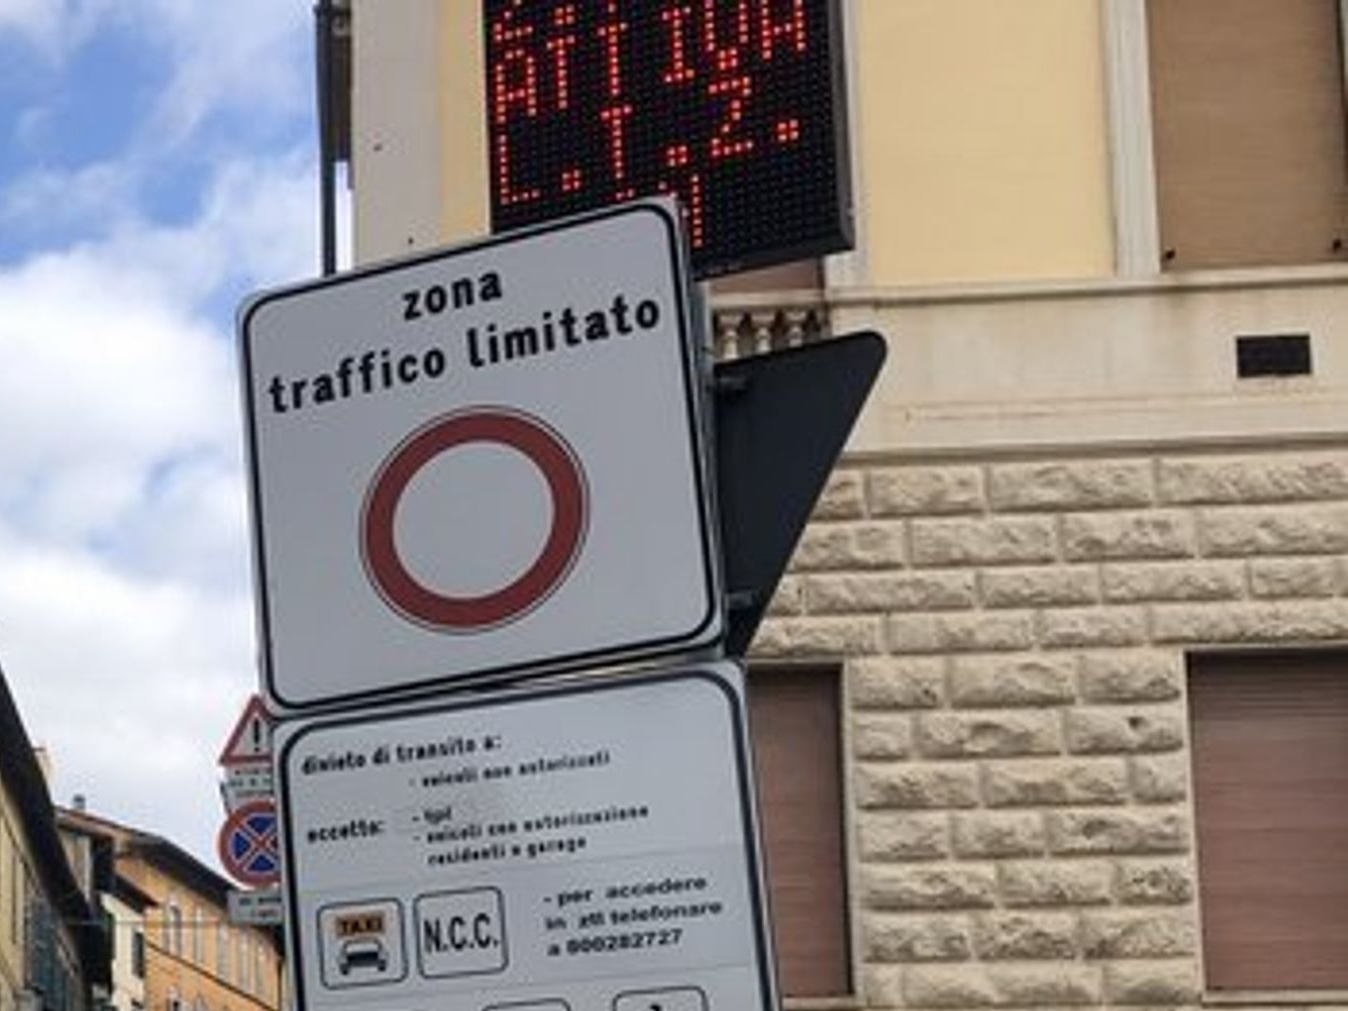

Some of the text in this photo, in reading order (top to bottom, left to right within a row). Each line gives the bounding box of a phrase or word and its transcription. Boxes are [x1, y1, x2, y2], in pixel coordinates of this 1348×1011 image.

[403, 271, 503, 320] zona
[269, 294, 659, 413] traffico limitato
[302, 735, 502, 775] divieto di transito a:
[422, 767, 477, 787] veicoli
[519, 751, 610, 775] autorizzati
[307, 819, 385, 843] eccetto:
[427, 826, 482, 843] veicoli
[488, 822, 517, 837] con
[523, 804, 649, 833] autorizzazione
[428, 845, 505, 865] residenti
[526, 837, 587, 858] garage
[558, 889, 593, 908] per
[605, 877, 707, 898] accedere
[340, 915, 384, 935] TAXI
[546, 916, 567, 931] in
[610, 902, 723, 924] telefonare
[424, 913, 500, 954] N.C.C.
[548, 929, 683, 957] a 800282727
